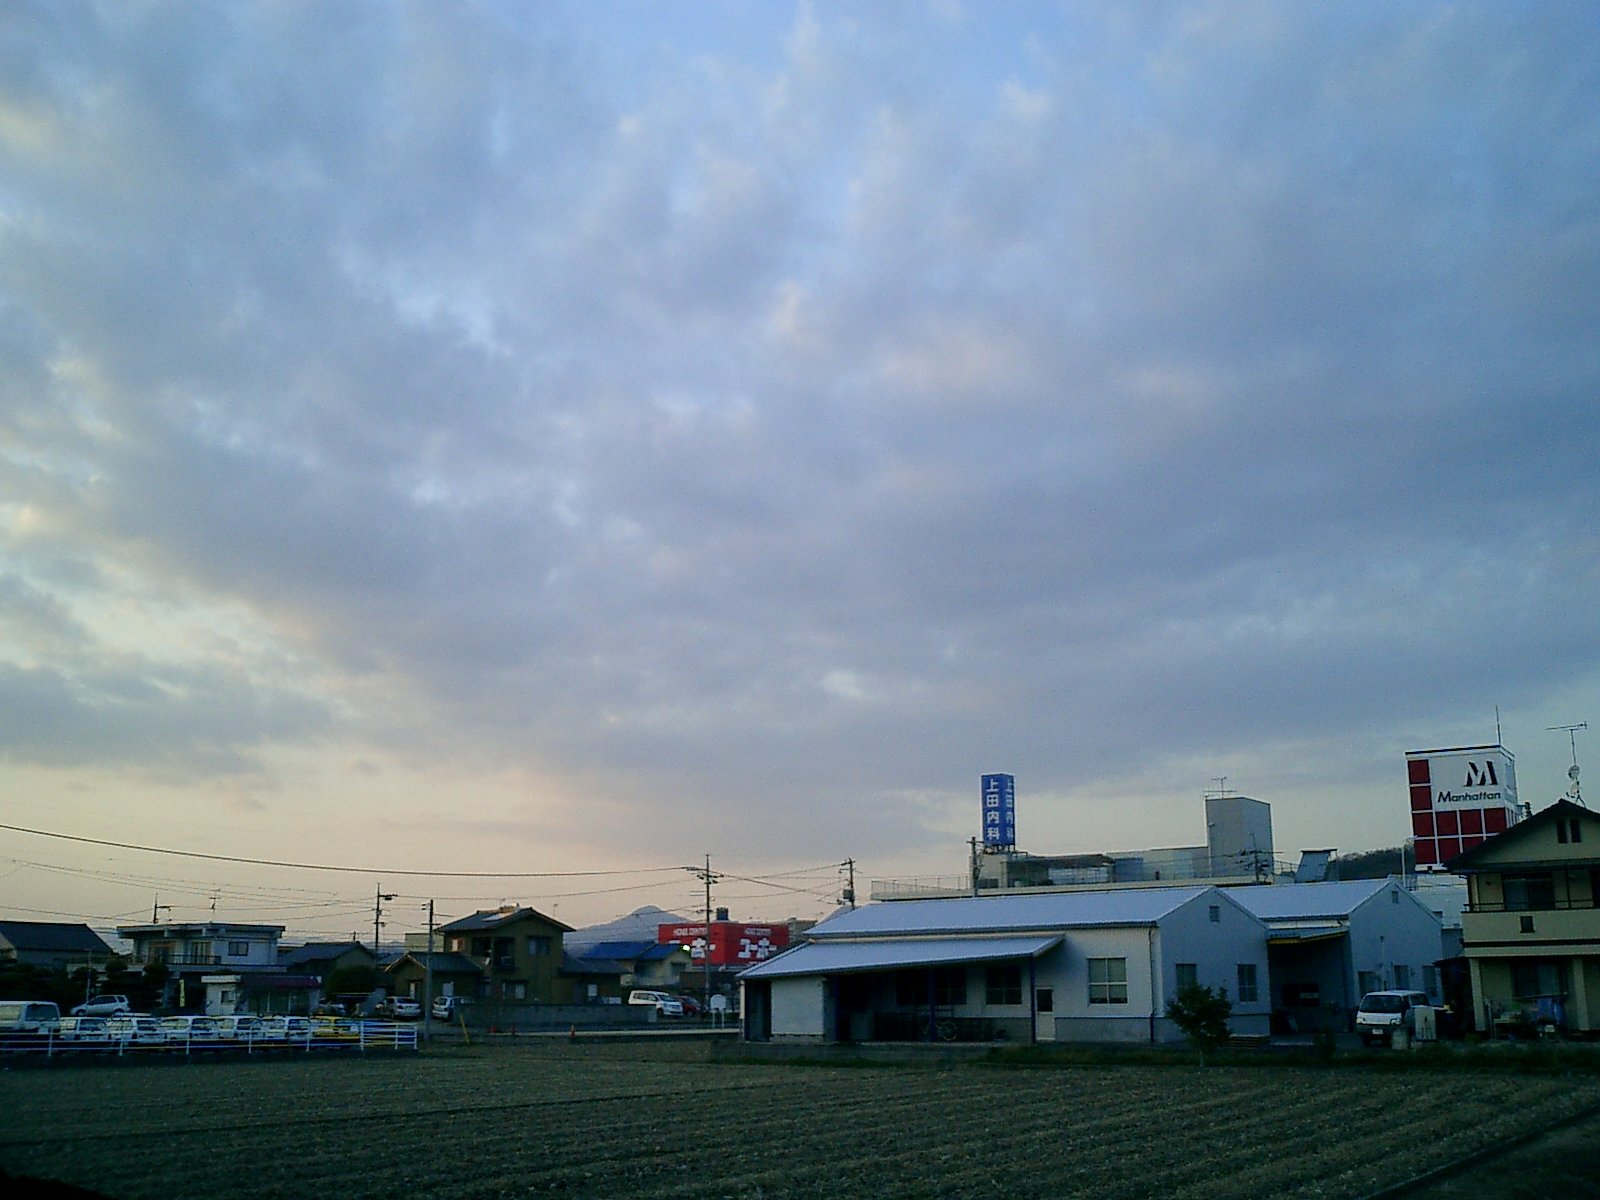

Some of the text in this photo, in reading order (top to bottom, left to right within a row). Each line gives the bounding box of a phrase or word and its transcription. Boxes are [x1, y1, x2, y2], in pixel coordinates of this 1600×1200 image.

[985, 778, 1000, 840] 上田内科
[1437, 791, 1501, 803] Manhattan
